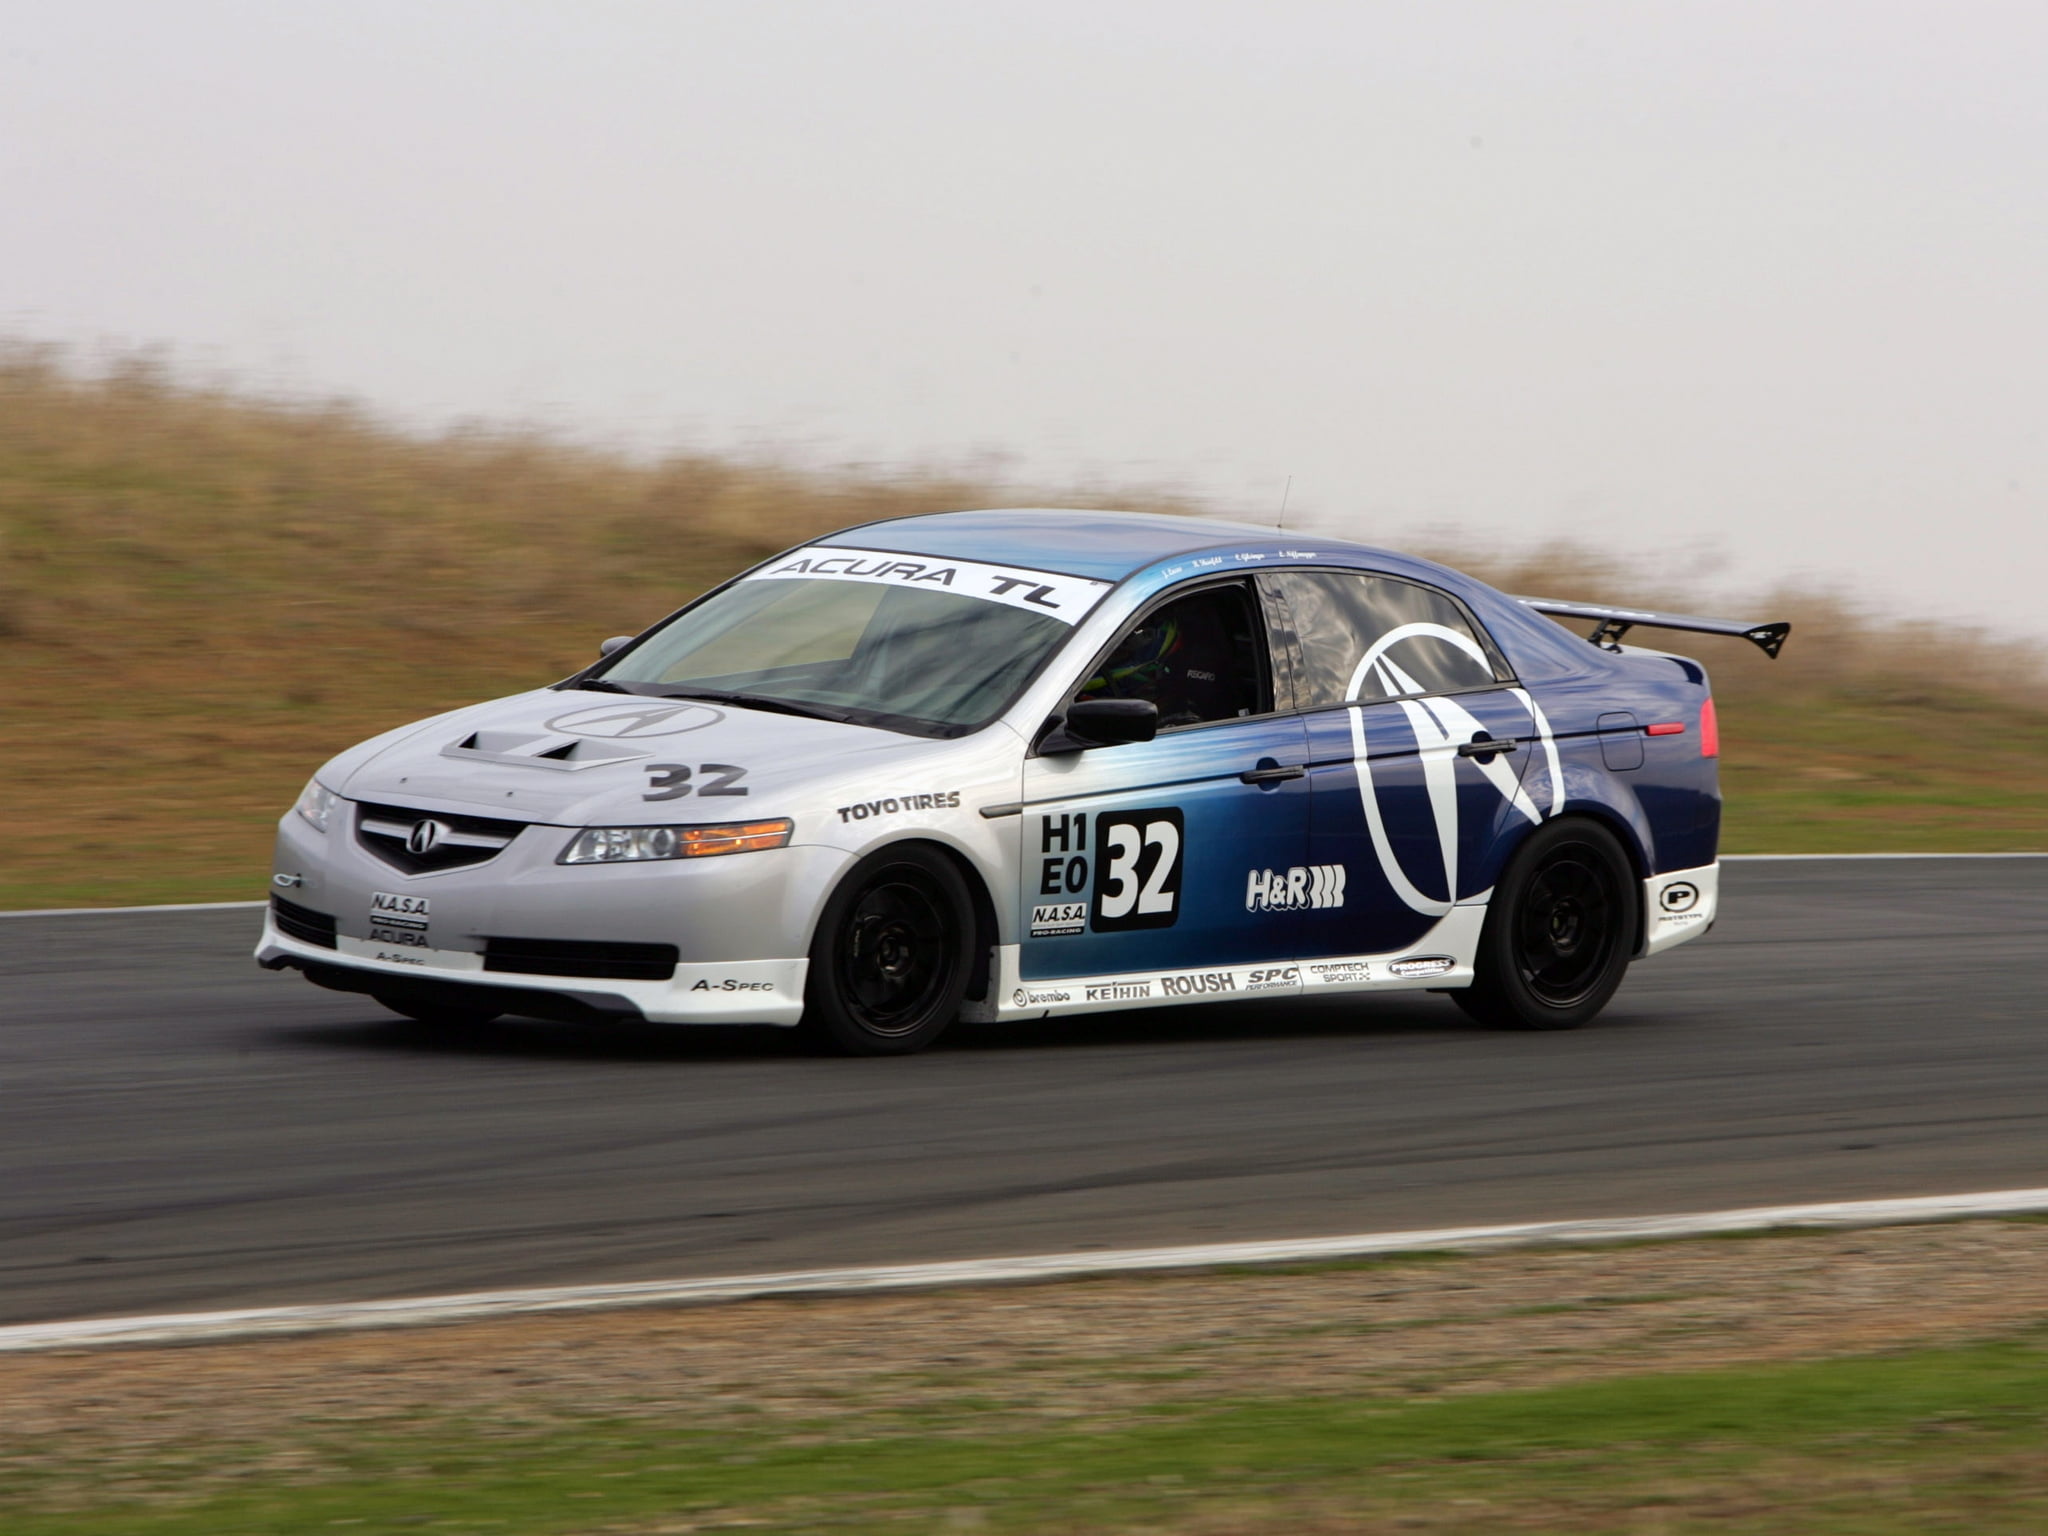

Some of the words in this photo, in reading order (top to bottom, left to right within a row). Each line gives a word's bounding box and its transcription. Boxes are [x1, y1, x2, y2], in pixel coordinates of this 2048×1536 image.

[771, 558, 957, 586] ACURA
[989, 575, 1062, 609] TL
[642, 763, 749, 802] 32
[837, 798, 899, 824] TOYO
[899, 790, 961, 812] TIRES
[1041, 812, 1087, 853] H1
[1040, 855, 1088, 895] E0
[1101, 819, 1180, 919] 32
[1247, 865, 1309, 912] H&R
[369, 928, 430, 948] ACURA
[1249, 967, 1299, 983] SPC
[1310, 962, 1369, 975] COMPTECH
[1391, 959, 1451, 971] PROGRESS
[1027, 988, 1071, 1004] brembo
[1086, 982, 1151, 1001] KEIHIN
[1161, 972, 1236, 997] ROUSH
[1245, 980, 1298, 990] PERFORMANCE
